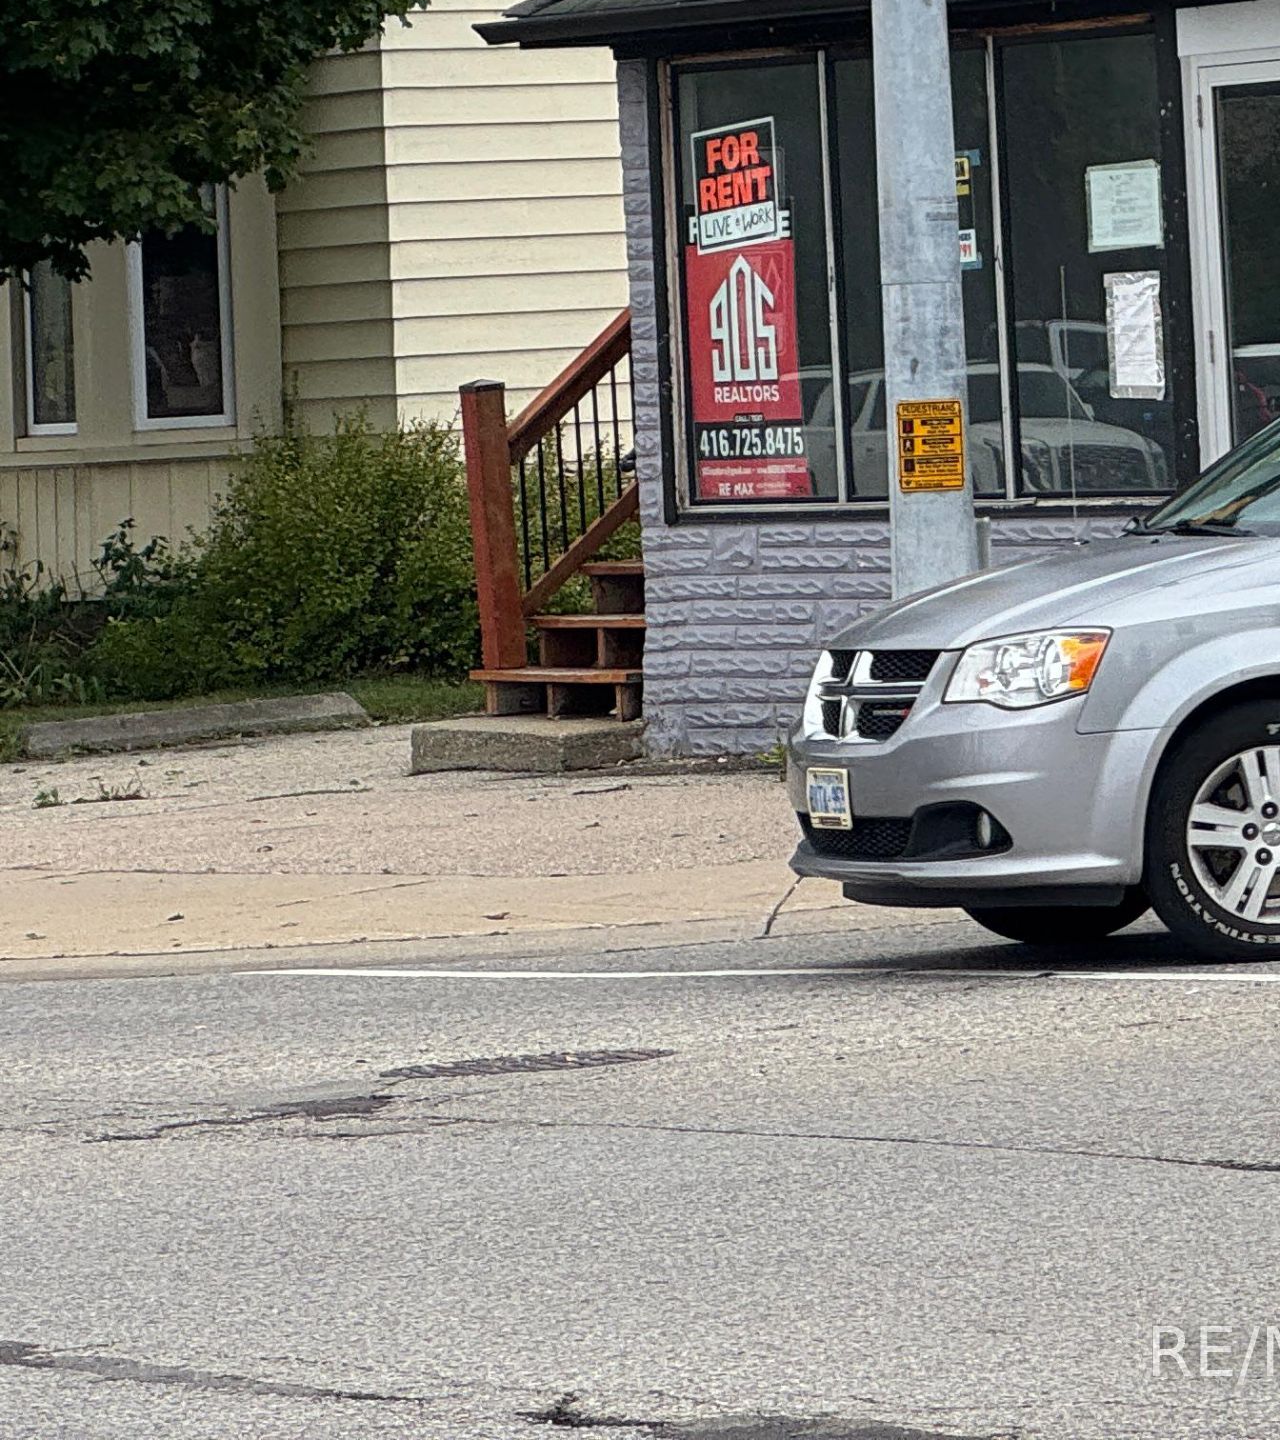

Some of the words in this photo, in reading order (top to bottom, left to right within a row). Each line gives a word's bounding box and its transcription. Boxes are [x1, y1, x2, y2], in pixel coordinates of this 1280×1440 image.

[706, 131, 760, 174] FOR
[700, 165, 771, 212] RENT
[704, 214, 732, 238] LIVE
[742, 207, 774, 232] WORK
[709, 253, 778, 382] 905
[714, 385, 780, 403] REALTORS
[902, 403, 956, 414] PEDESTRIANS
[700, 427, 804, 457] 416.725.8475
